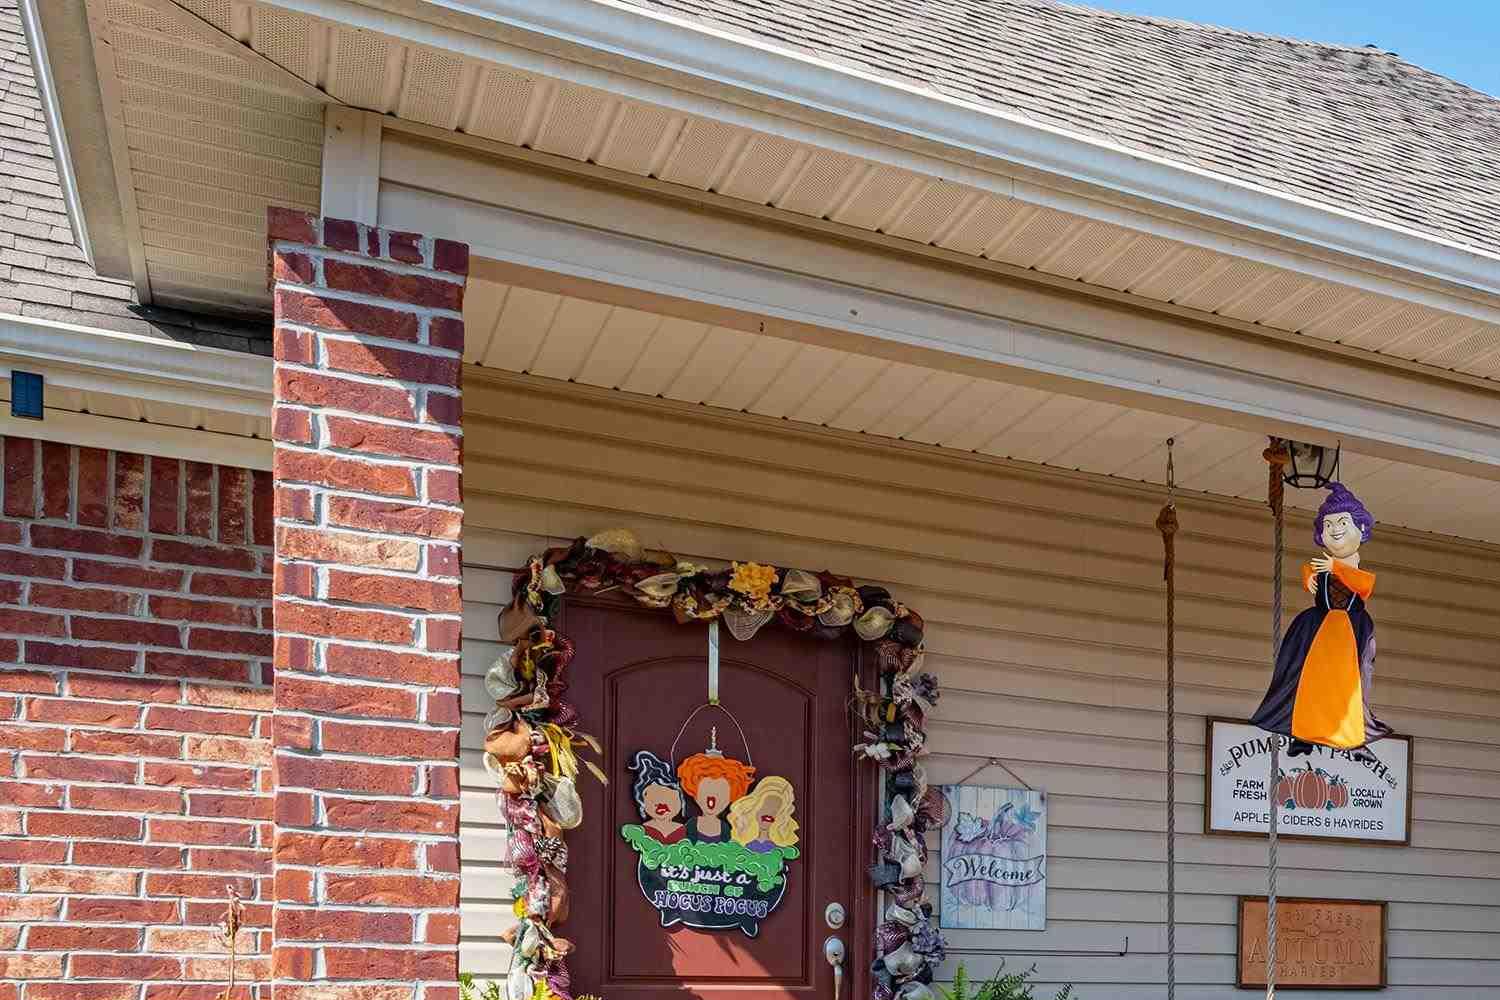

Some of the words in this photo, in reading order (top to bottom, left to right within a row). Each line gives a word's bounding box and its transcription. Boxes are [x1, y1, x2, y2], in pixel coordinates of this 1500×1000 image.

[1236, 779, 1264, 790] FARM
[1232, 789, 1267, 800] FRESH
[1350, 787, 1386, 799] LOCALLY
[1352, 798, 1383, 809] GROWN
[1233, 811, 1278, 825] APPLE
[1283, 814, 1322, 828] CIDERS
[1324, 819, 1331, 828] &
[1333, 818, 1384, 831] HAYRIDES
[660, 863, 690, 879] it's
[690, 866, 732, 884] just
[735, 872, 752, 885] a
[954, 857, 1034, 881] Welcome
[654, 889, 713, 913] HOCUS
[714, 895, 769, 919] POCUS
